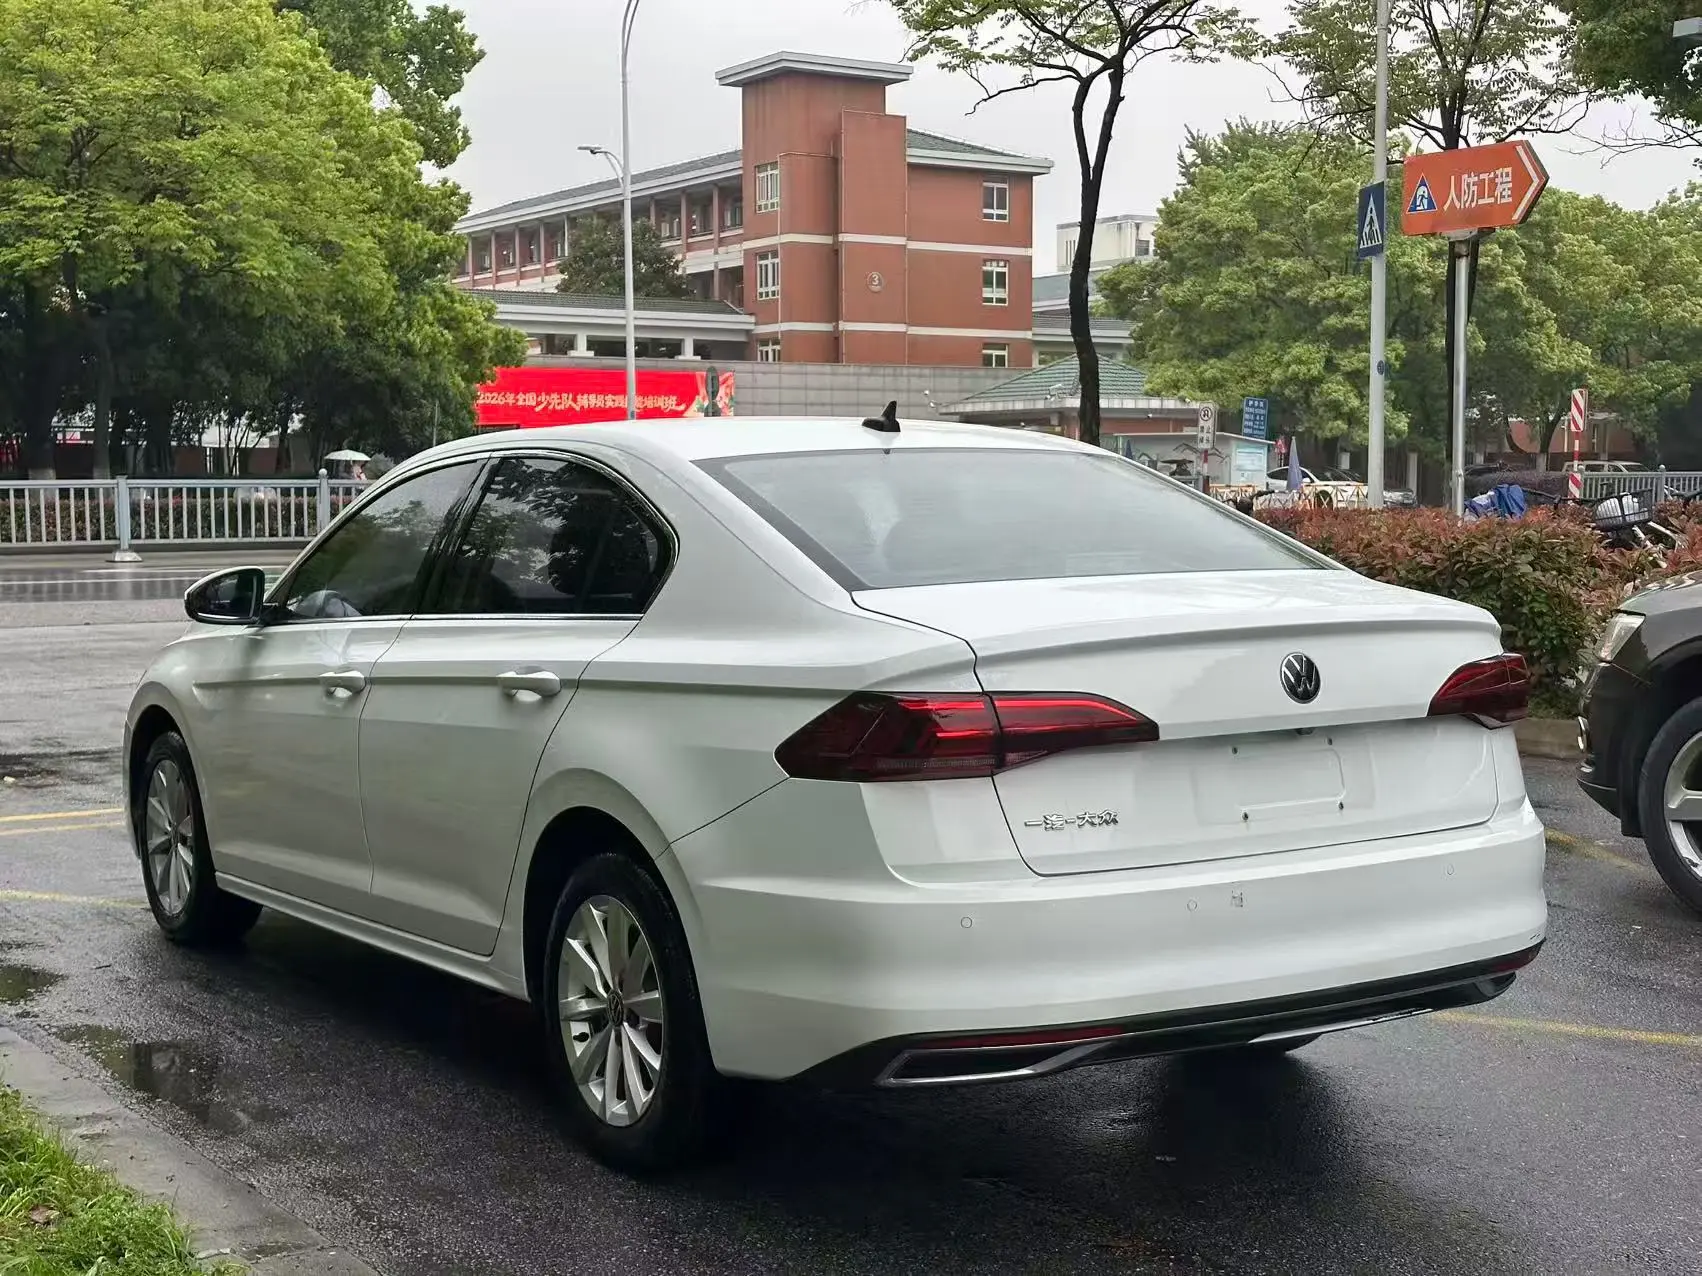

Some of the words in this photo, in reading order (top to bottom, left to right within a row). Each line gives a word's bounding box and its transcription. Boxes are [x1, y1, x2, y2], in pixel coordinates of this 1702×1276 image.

[1443, 167, 1513, 212] 人防工程
[1024, 808, 1119, 831] 一汽-大众
